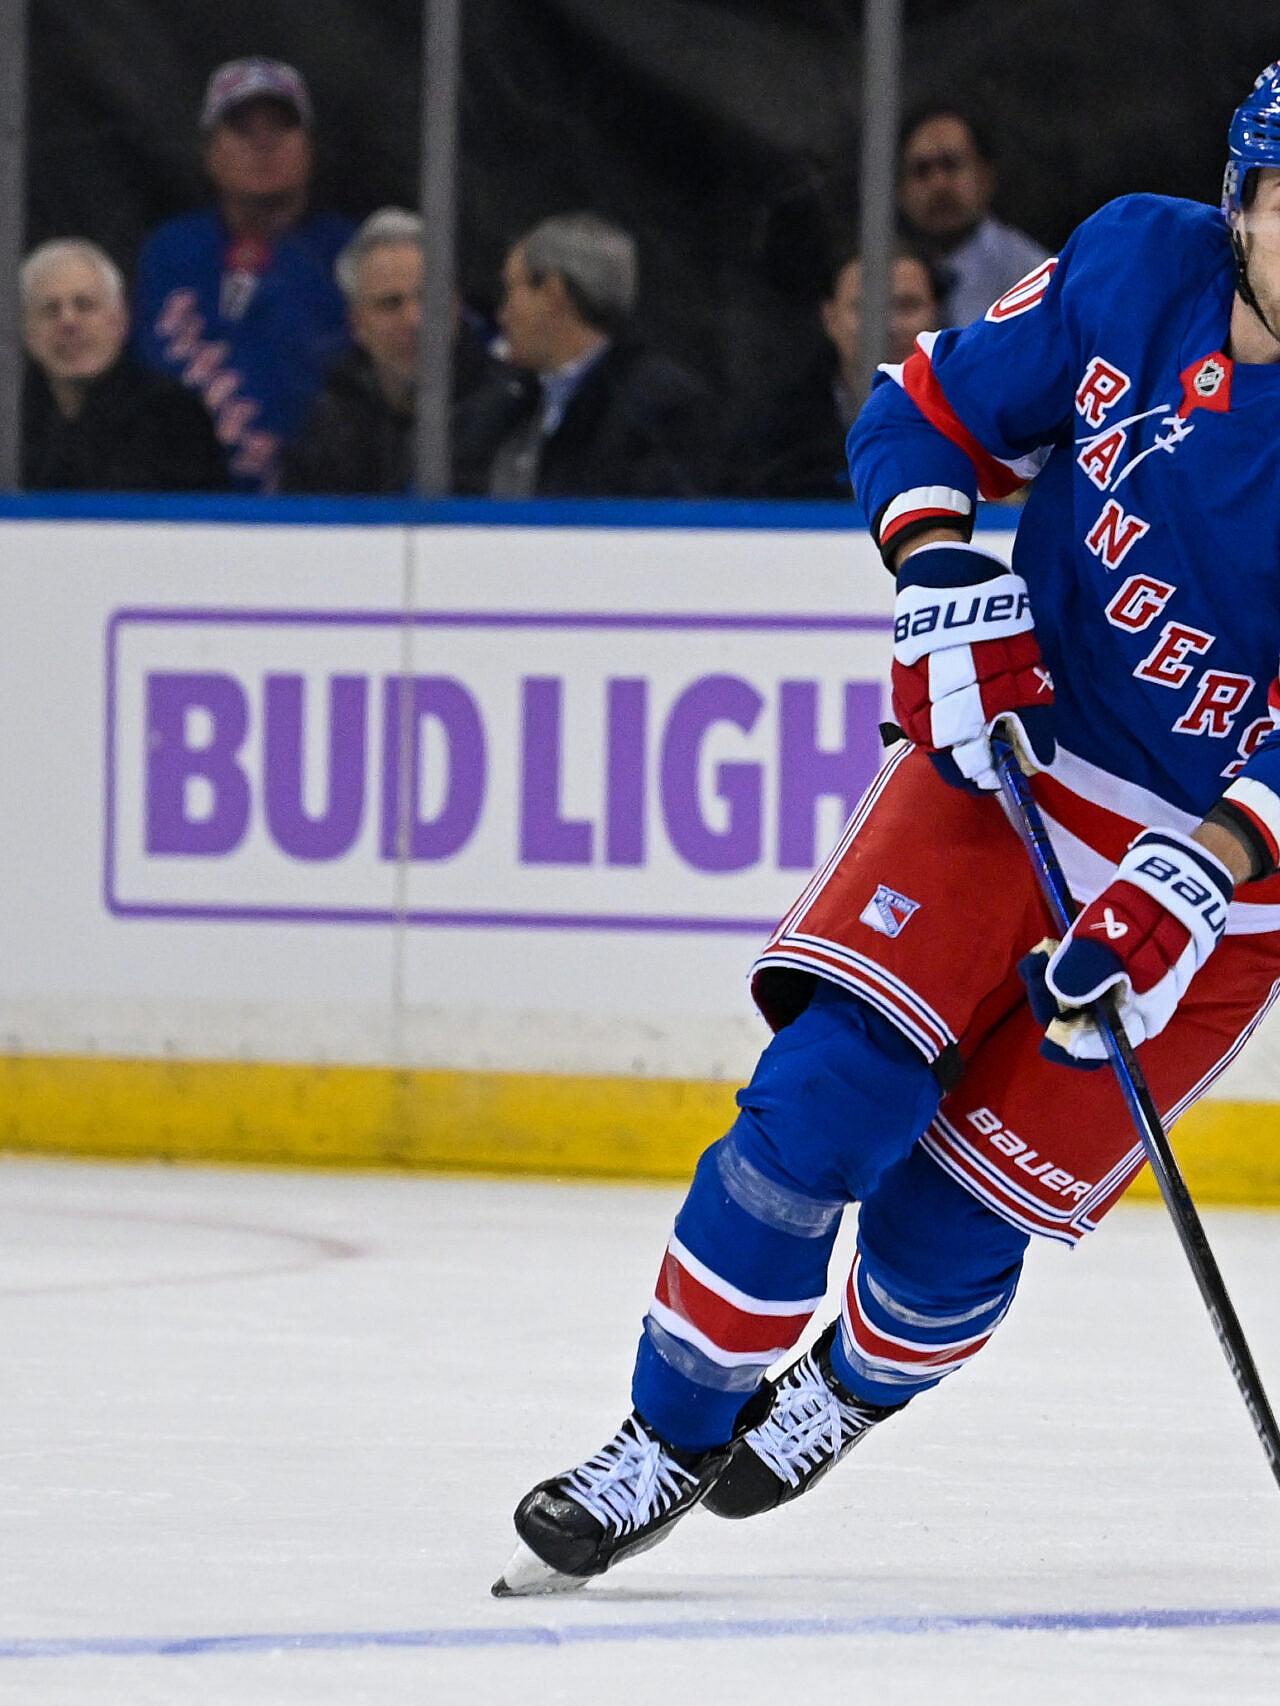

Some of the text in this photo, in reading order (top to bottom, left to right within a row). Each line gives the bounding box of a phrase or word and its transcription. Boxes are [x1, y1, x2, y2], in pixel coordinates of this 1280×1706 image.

[143, 670, 488, 865] BUD
[1135, 856, 1226, 944] BAU
[966, 1107, 1093, 1201] BAUER
